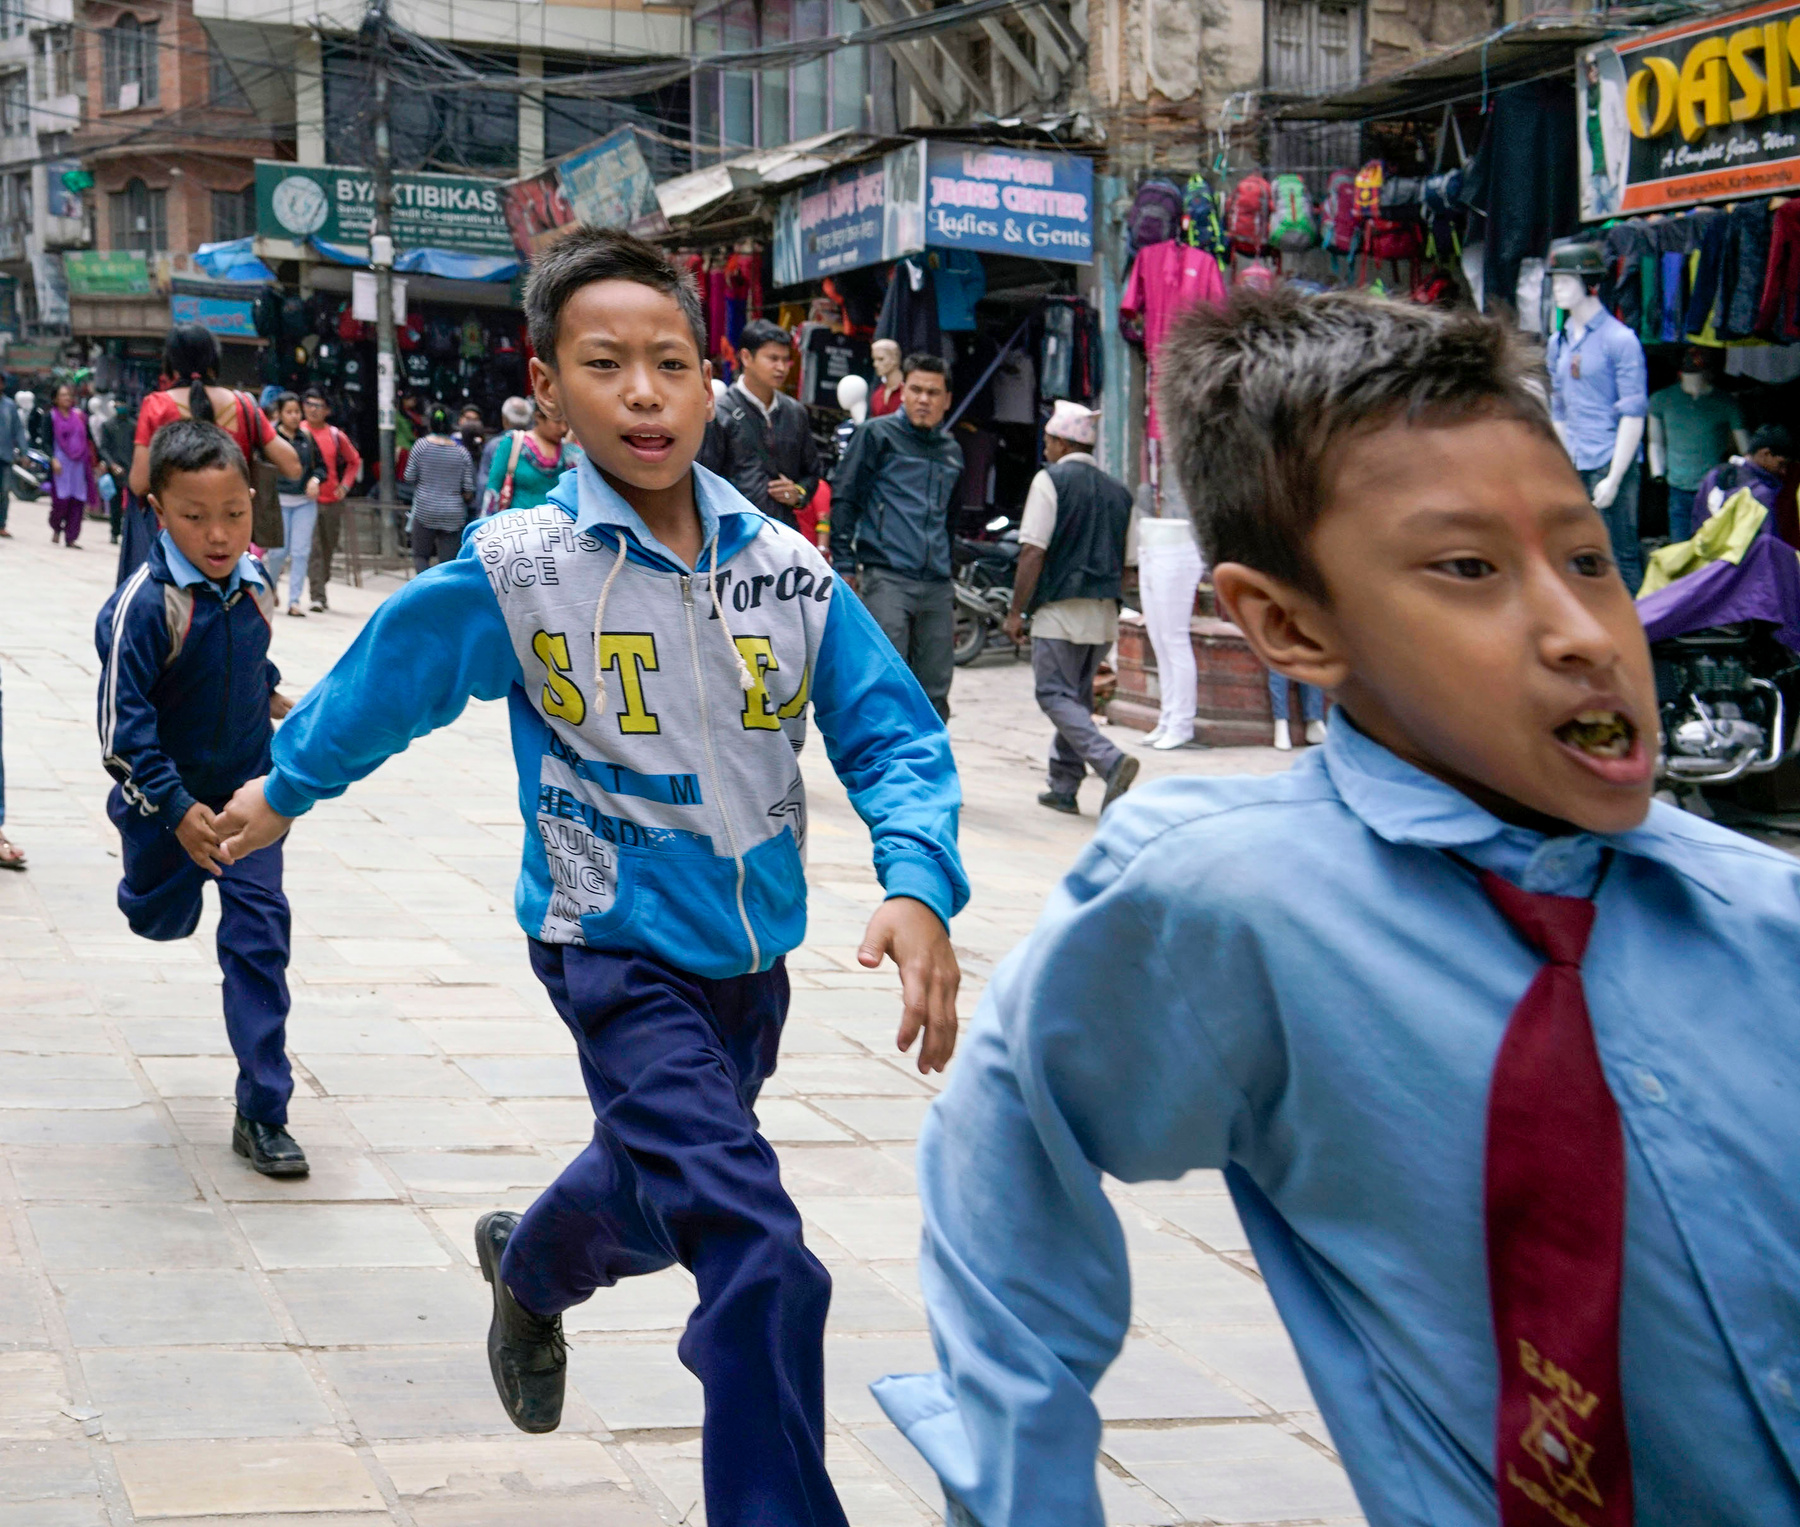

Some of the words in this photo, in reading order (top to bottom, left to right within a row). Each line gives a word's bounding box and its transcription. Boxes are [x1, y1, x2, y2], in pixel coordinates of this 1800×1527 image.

[962, 151, 1054, 186] LAXMAN
[930, 176, 1000, 209] JEANS
[1001, 185, 1088, 222] CENTER
[927, 208, 998, 240] Ladies
[1003, 218, 1024, 243] &
[1026, 221, 1092, 247] Gents
